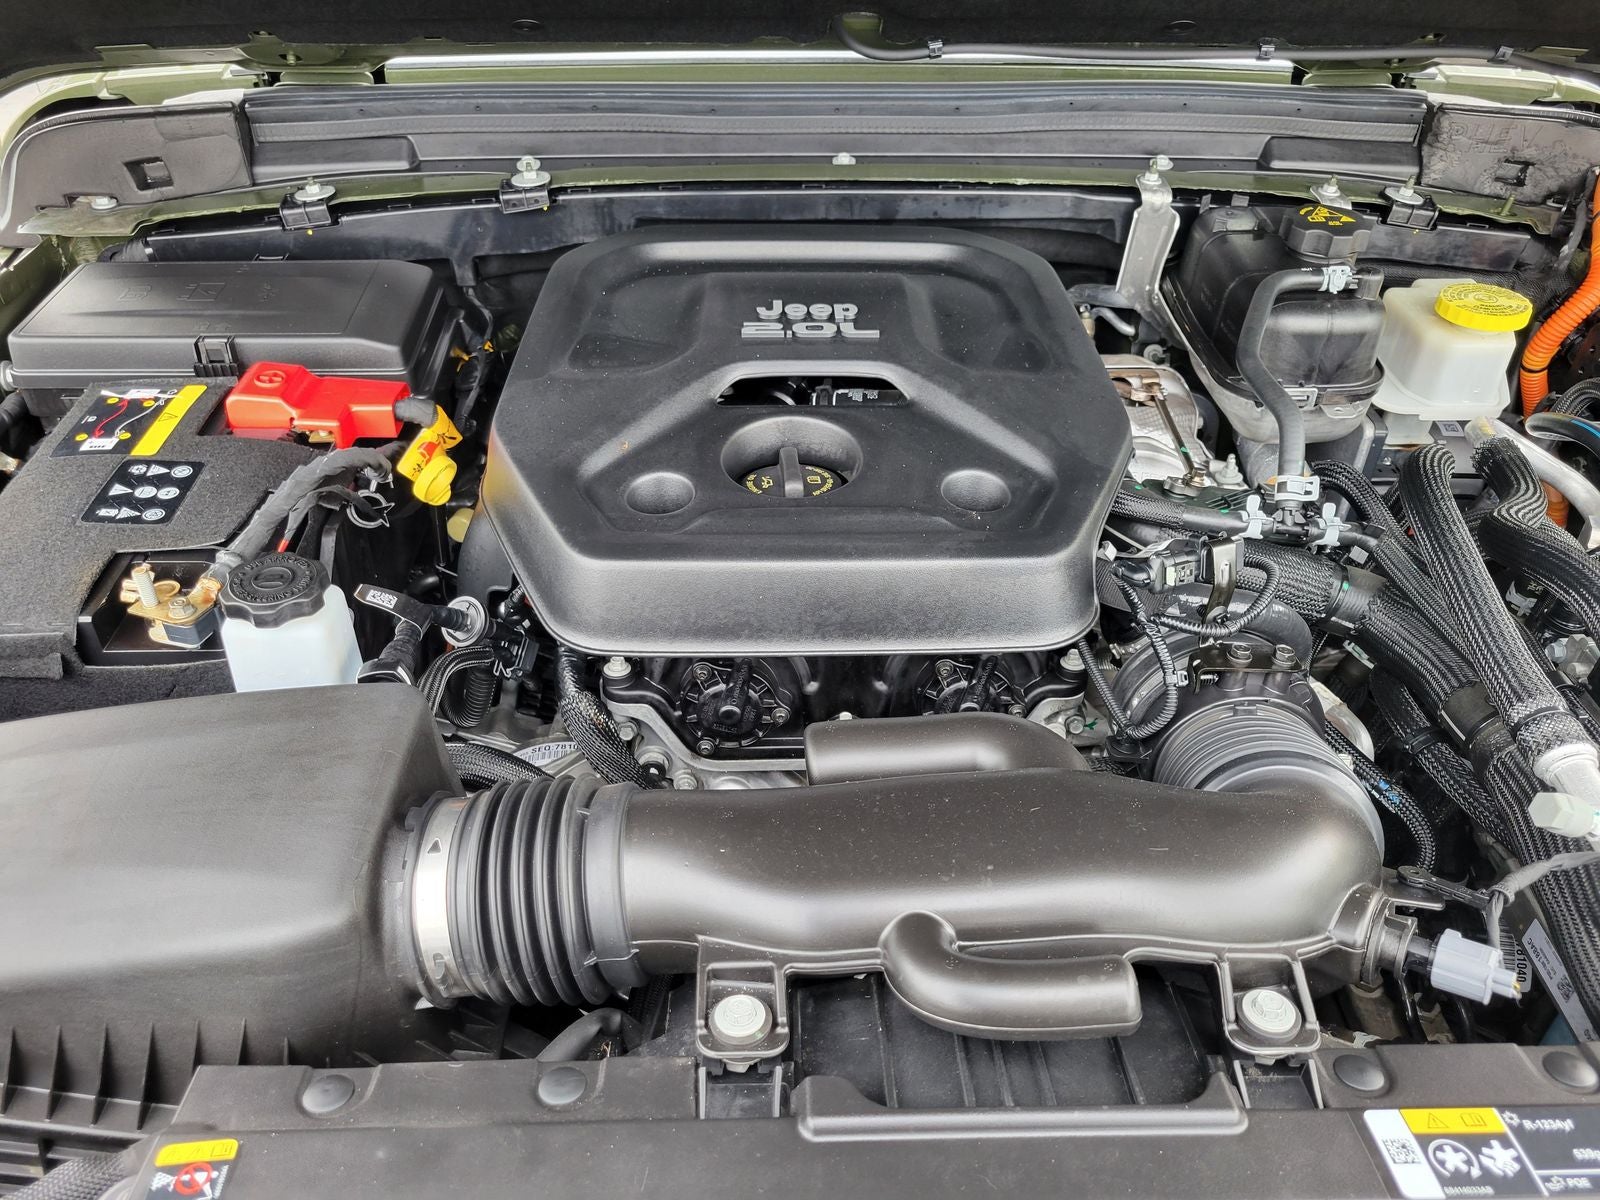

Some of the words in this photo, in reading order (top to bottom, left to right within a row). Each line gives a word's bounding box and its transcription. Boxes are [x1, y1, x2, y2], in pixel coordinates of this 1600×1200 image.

[756, 299, 859, 323] Jeep
[741, 321, 880, 338] 2.0L
[1522, 1119, 1575, 1132] R-1234yf
